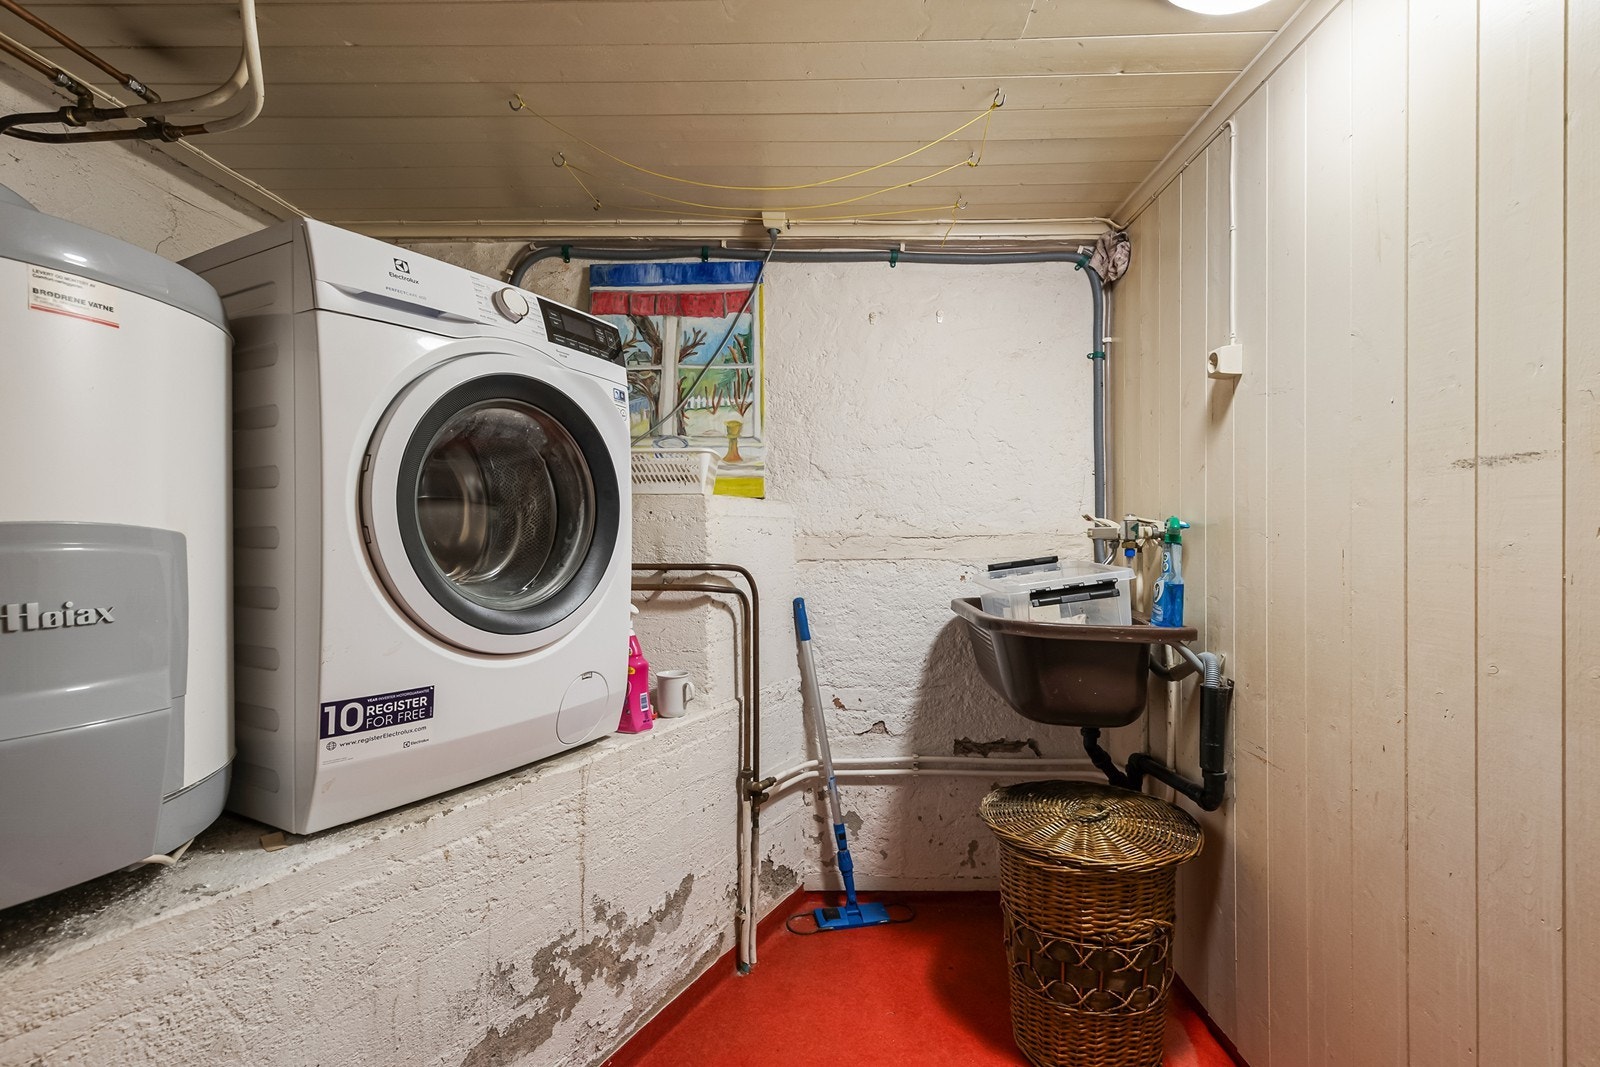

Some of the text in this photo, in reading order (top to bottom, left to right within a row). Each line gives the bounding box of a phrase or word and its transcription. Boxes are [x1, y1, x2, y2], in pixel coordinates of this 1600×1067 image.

[32, 268, 54, 277] LEVERT
[388, 271, 419, 284] Electrolux
[32, 287, 87, 306] BRØDRENE
[88, 300, 114, 312] VATNE
[0, 601, 115, 632] Høiax
[366, 696, 428, 716] REGISTER
[324, 702, 364, 736] 10
[366, 714, 393, 729] FOR
[397, 707, 426, 723] FREE
[339, 725, 427, 747] www.registerElectrolux.com
[410, 738, 430, 746] Electrolux
